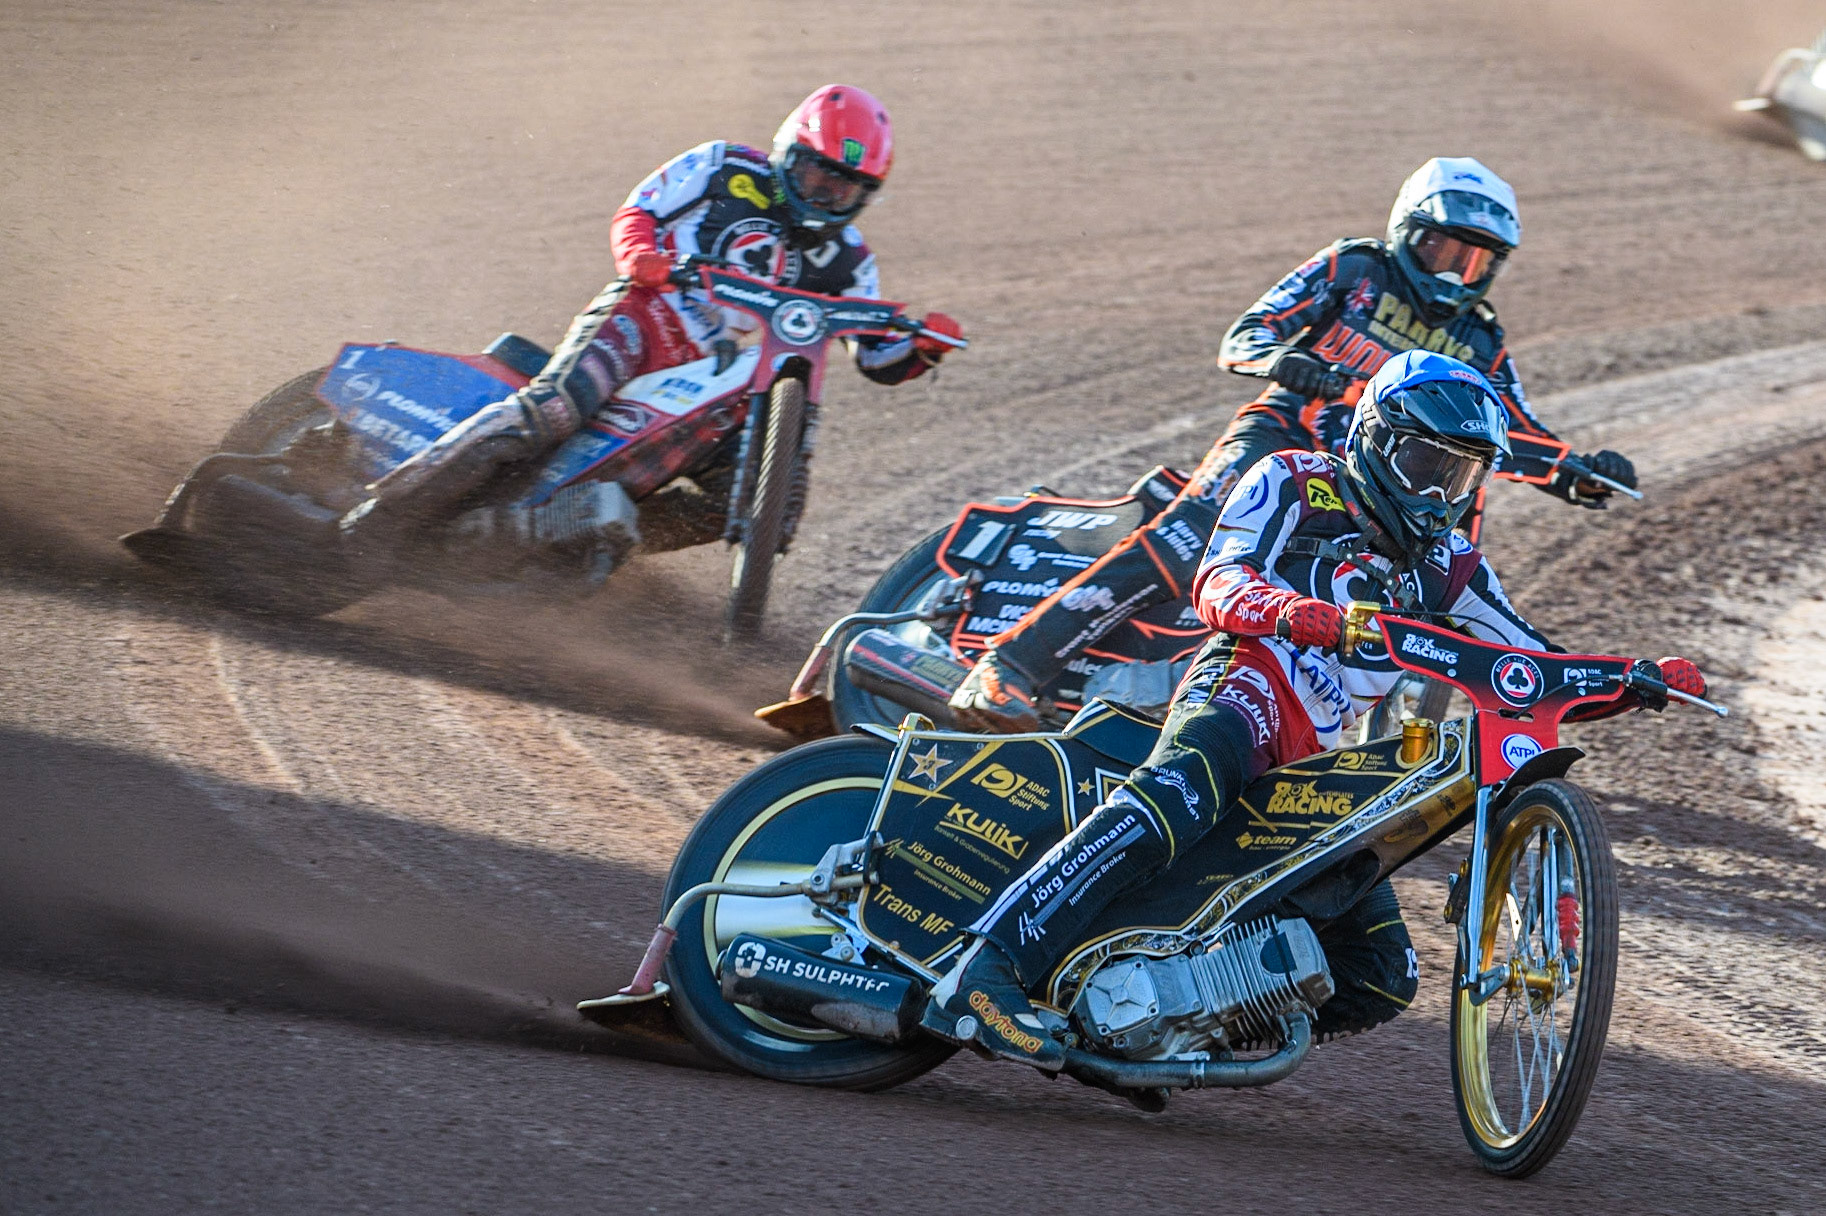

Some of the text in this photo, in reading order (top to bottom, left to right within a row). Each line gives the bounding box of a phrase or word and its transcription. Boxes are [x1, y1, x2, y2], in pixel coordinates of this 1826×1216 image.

[1026, 511, 1118, 530] JWP
[959, 520, 1006, 559] 1
[1235, 602, 1267, 623] Sport
[1401, 641, 1458, 664] RACING
[1509, 745, 1536, 758] ATPI
[1017, 788, 1051, 811] Stiftung
[1025, 781, 1050, 797] ADAC
[1008, 795, 1033, 812] Sport
[1252, 834, 1297, 845] team
[907, 841, 992, 896] Jörg Grohmann
[1031, 813, 1137, 908] Jörg Grohmann
[1069, 851, 1127, 906] Insurance Broker
[942, 885, 963, 901] Broker
[873, 883, 955, 935] Trans MF
[764, 955, 789, 973] SH
[969, 990, 1044, 1053] daytona
